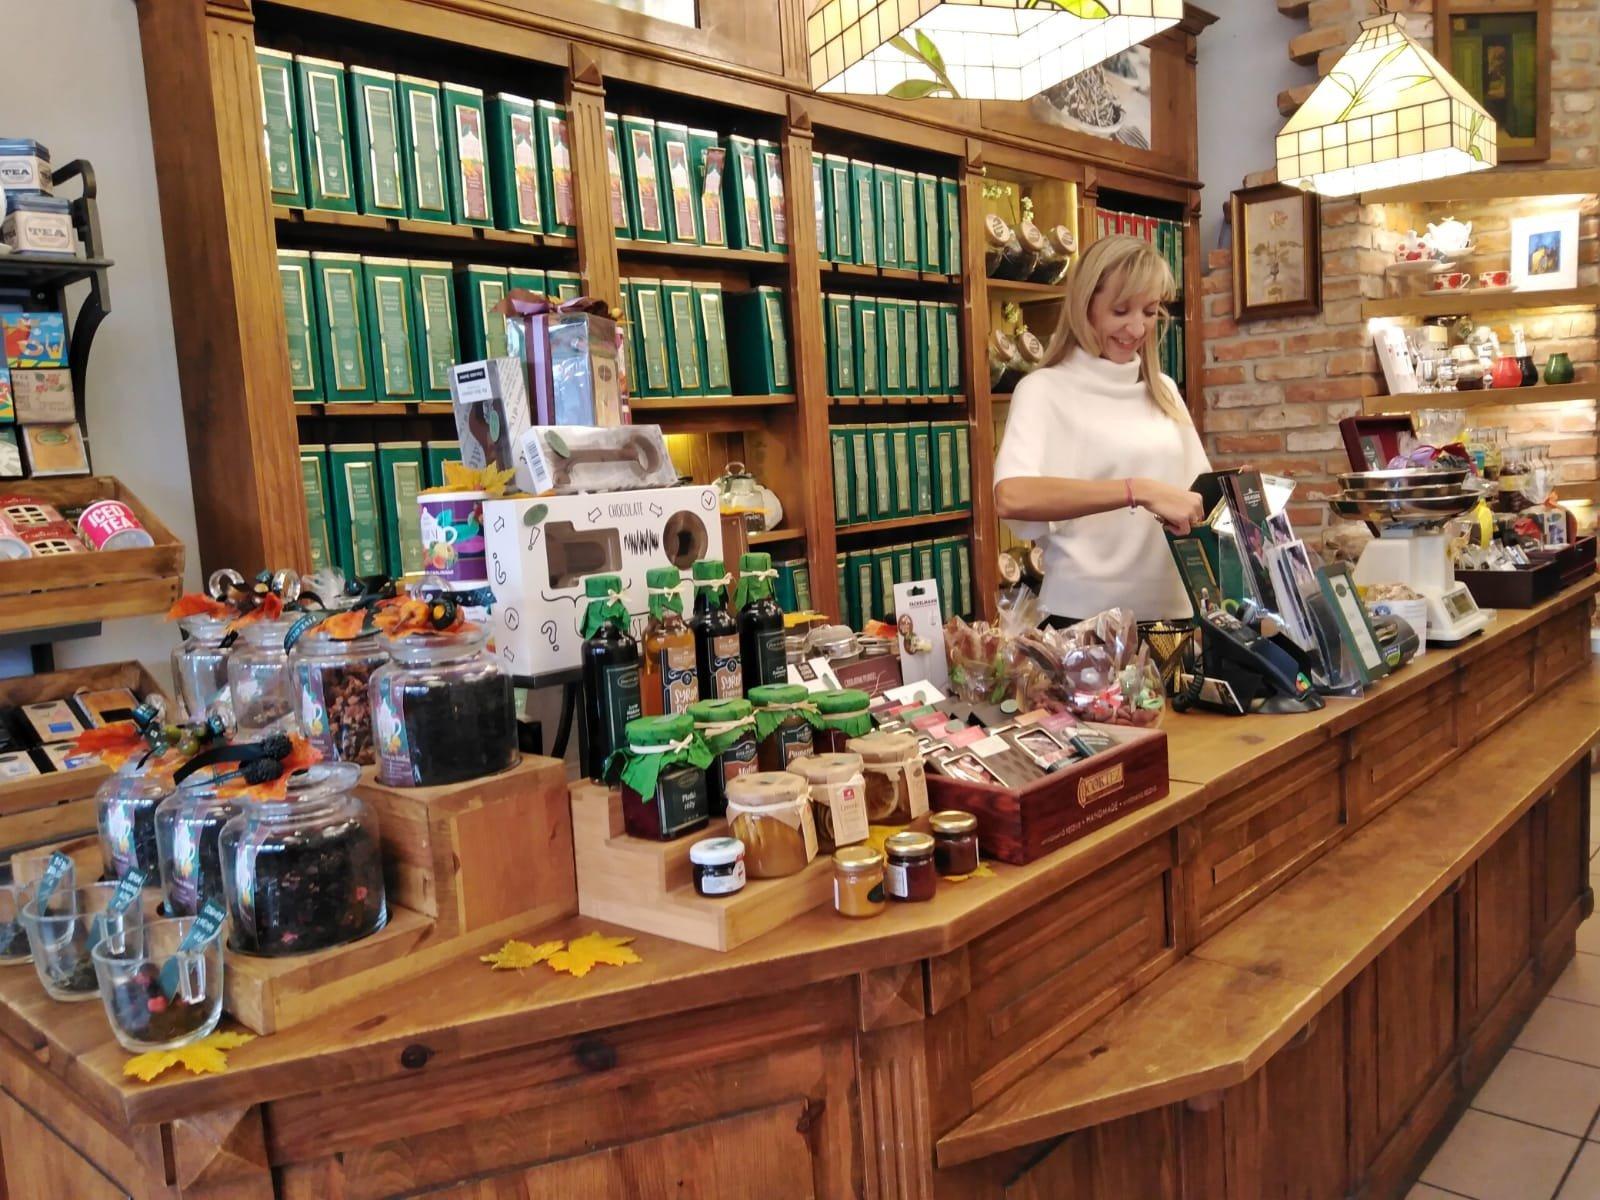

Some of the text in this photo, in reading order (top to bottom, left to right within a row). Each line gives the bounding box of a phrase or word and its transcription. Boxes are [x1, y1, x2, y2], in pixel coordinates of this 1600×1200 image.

[2, 168, 30, 176] TEA
[28, 227, 66, 238] TEA
[88, 505, 125, 528] ICED
[608, 501, 643, 519] CHOCOLATE
[99, 516, 135, 534] TEA
